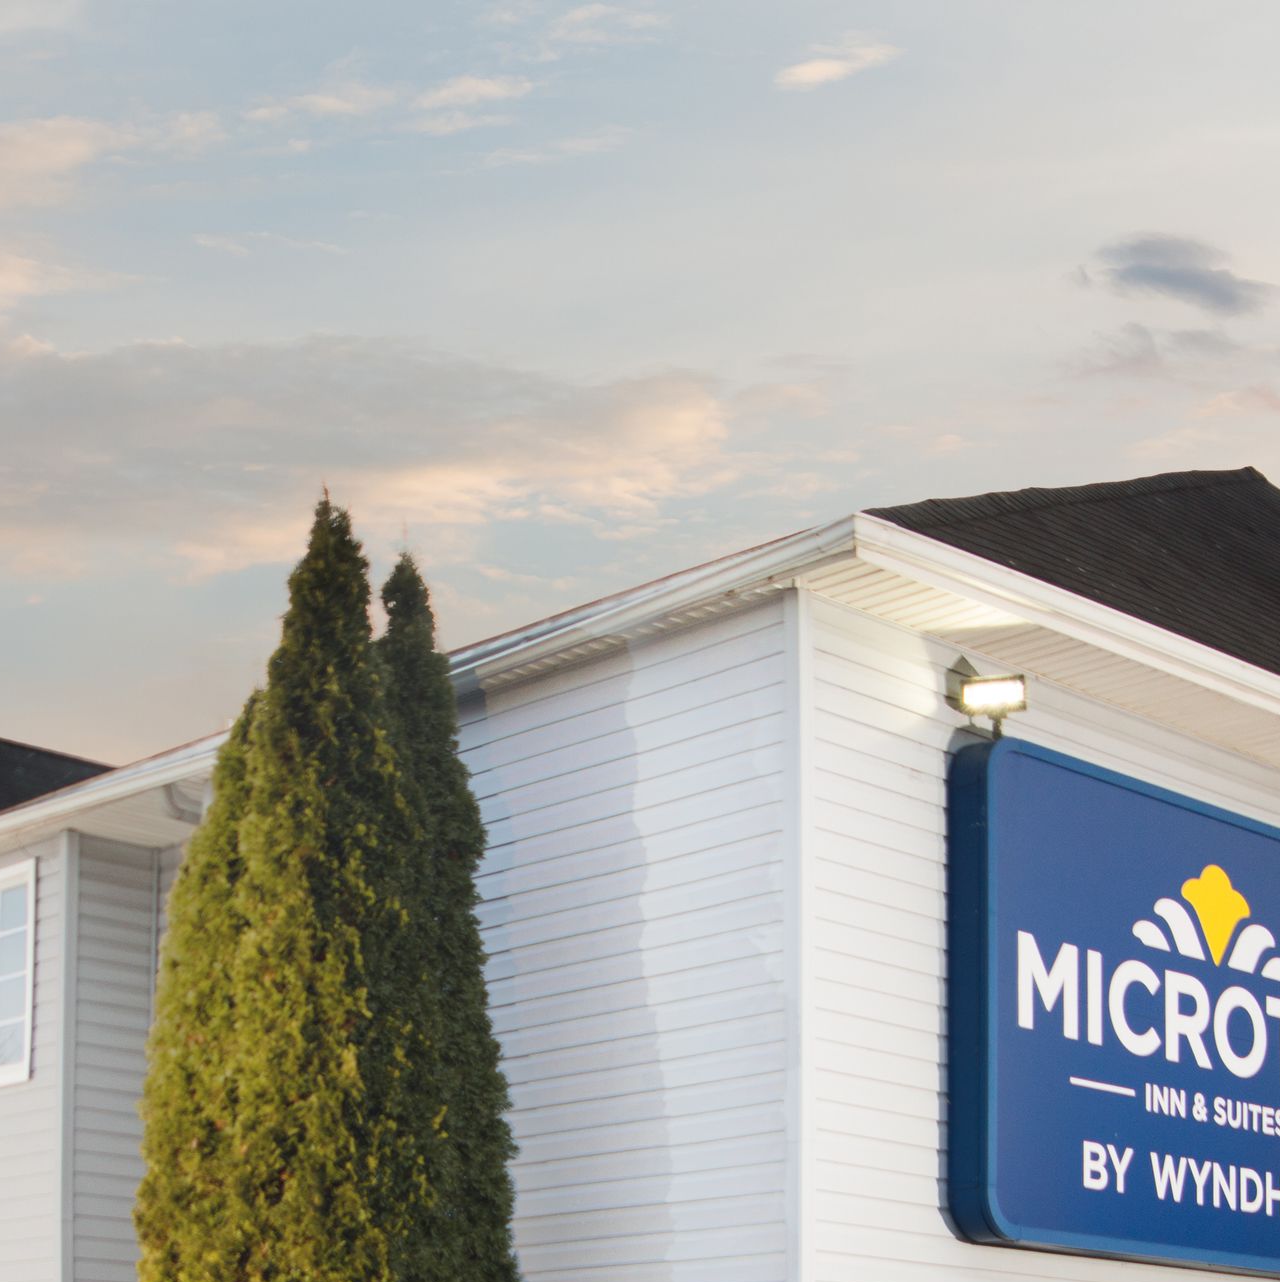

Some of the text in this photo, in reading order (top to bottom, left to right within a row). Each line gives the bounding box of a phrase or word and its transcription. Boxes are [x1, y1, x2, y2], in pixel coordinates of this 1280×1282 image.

[1145, 1082, 1187, 1119] INN
[1192, 1092, 1208, 1122] &
[1082, 1140, 1134, 1194] BY
